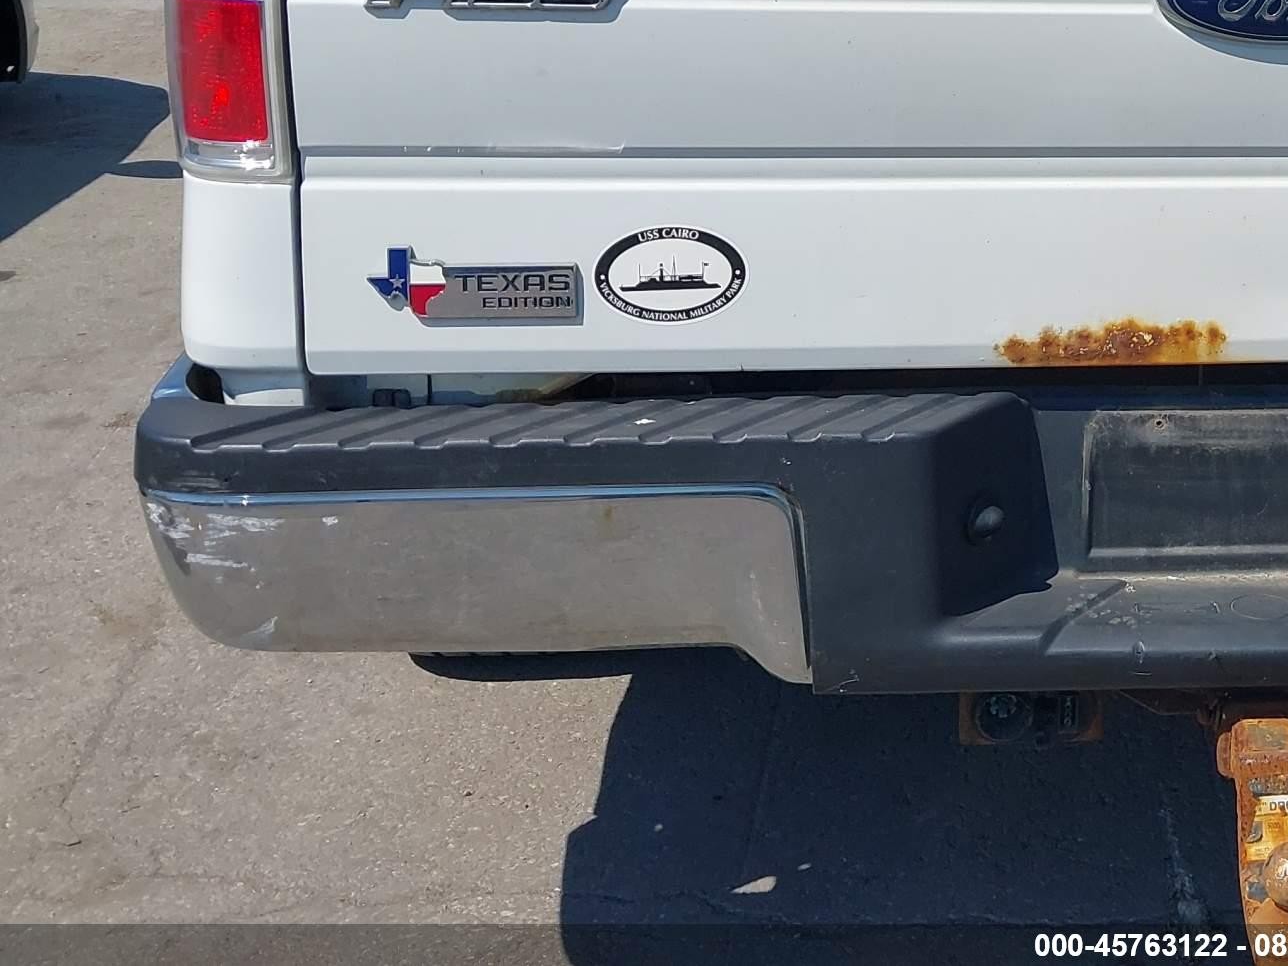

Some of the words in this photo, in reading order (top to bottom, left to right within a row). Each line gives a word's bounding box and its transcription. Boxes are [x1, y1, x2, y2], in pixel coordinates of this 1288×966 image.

[638, 229, 659, 242] USS
[662, 228, 699, 240] CAIRO
[454, 274, 571, 293] TEXAS
[482, 296, 573, 309] EDITION
[599, 281, 641, 317] VICKSBURG
[641, 310, 689, 322] NATIONAL
[689, 295, 728, 318] MILITARY
[725, 277, 742, 299] PARK
